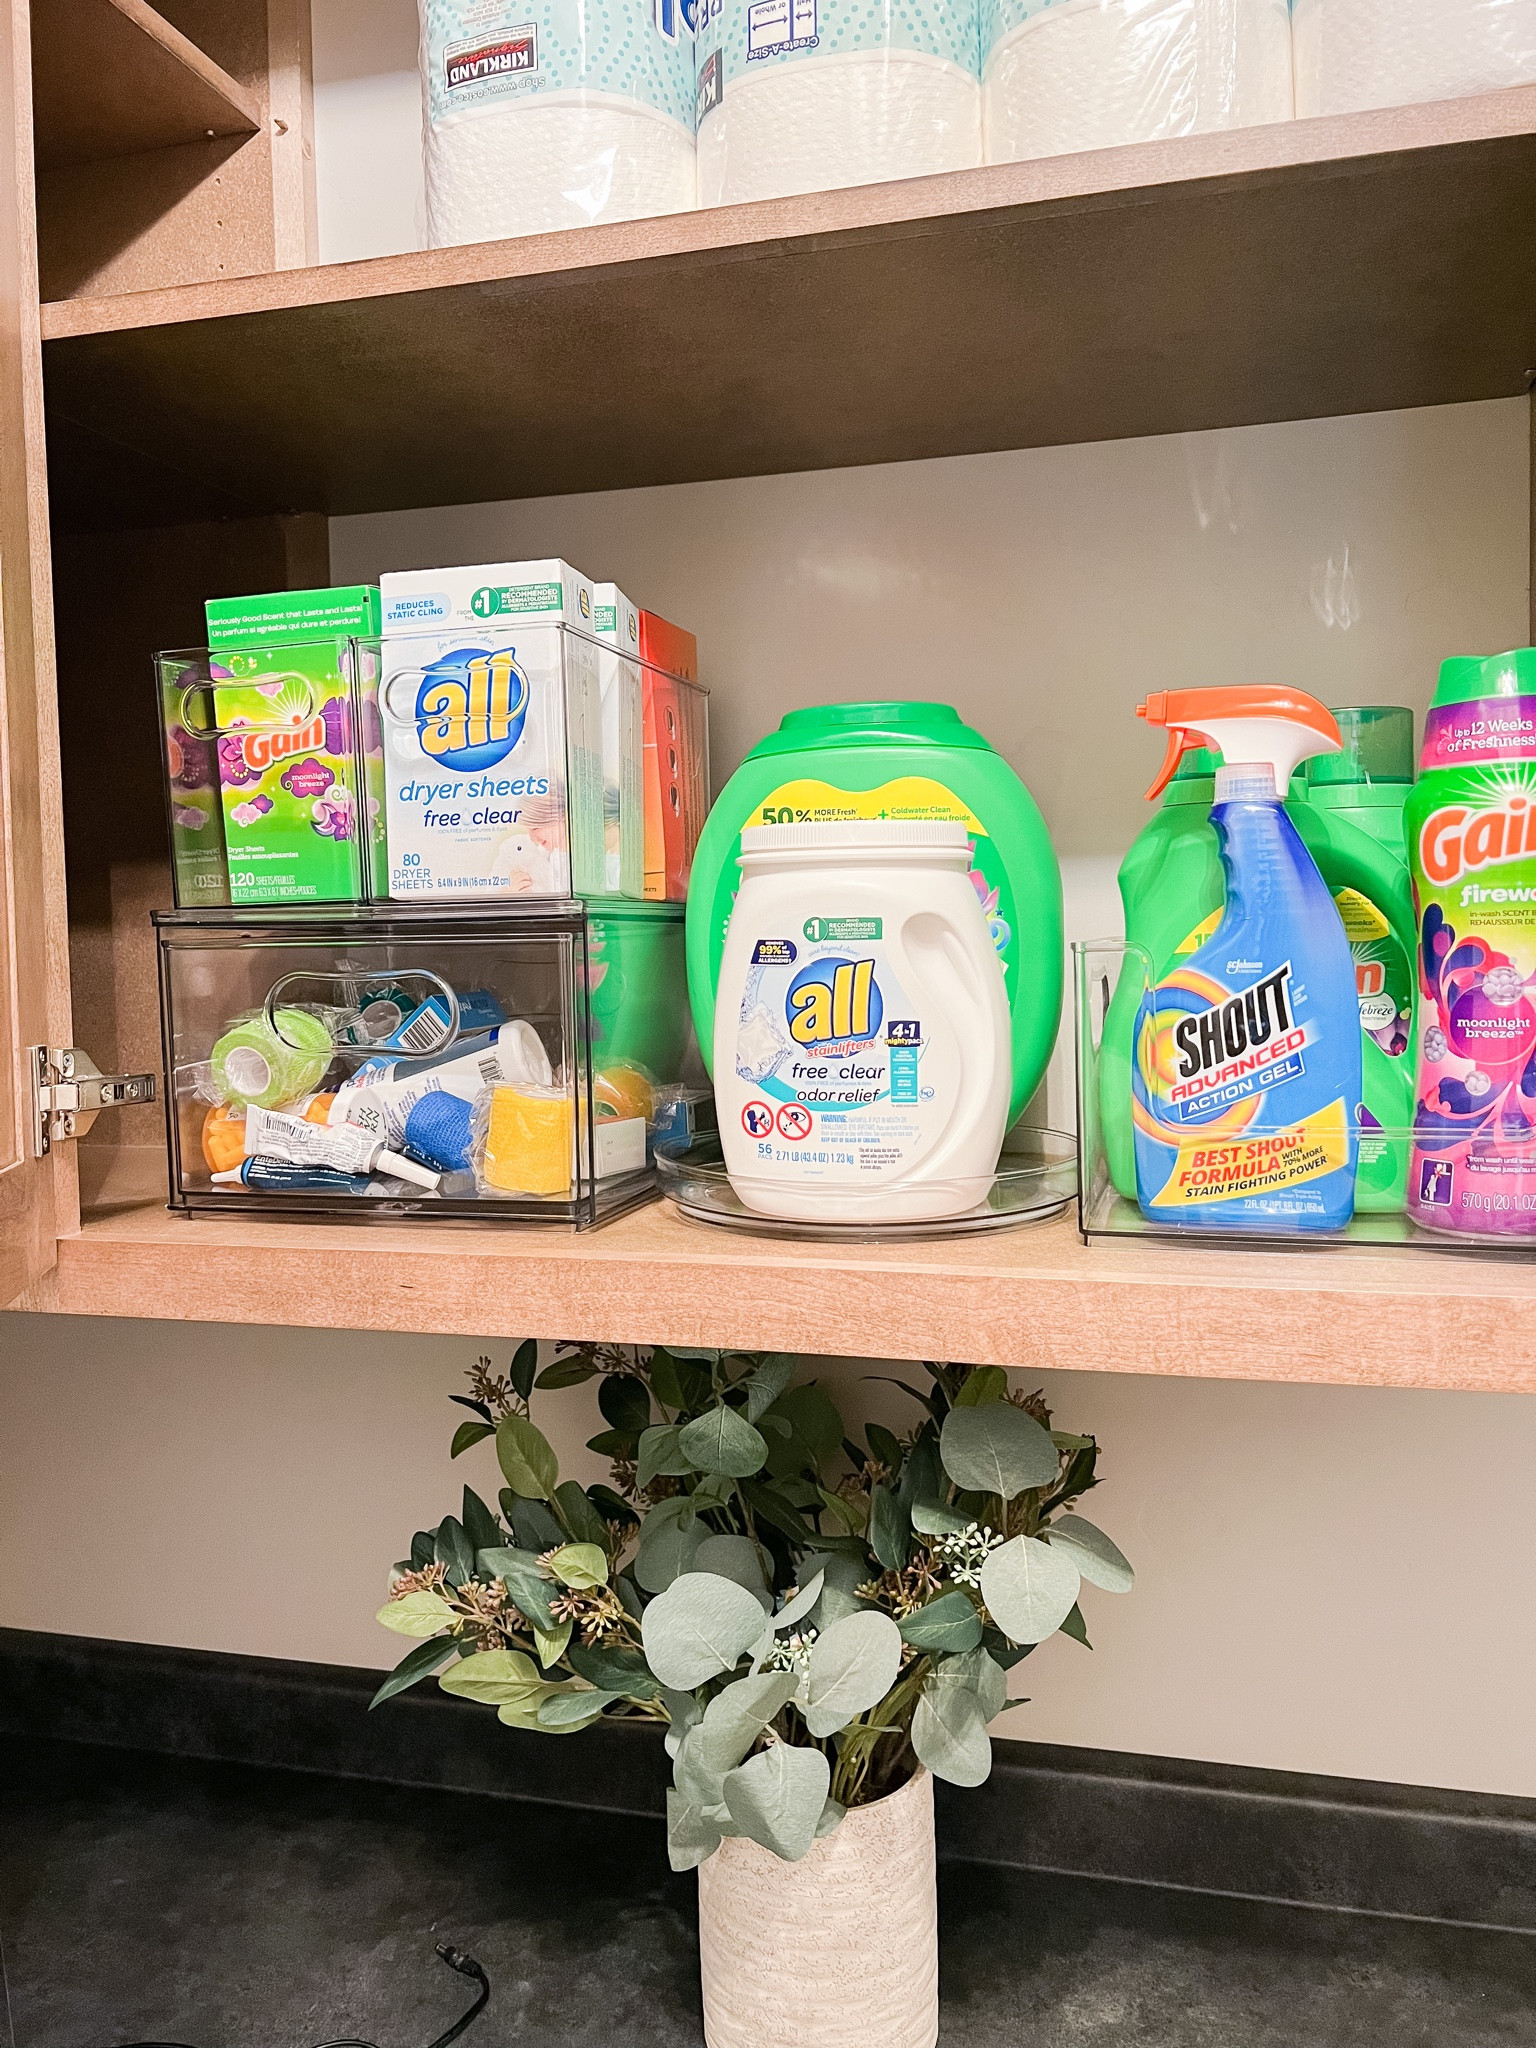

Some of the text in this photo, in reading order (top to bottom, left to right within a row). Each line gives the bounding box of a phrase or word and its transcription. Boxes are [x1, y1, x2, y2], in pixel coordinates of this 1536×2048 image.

[747, 36, 820, 60] Create-A-Size
[450, 50, 529, 83] KIRKLAND
[439, 76, 546, 111] Shop www.costco.com
[474, 590, 490, 614] #1
[501, 588, 558, 600] RECOMMENDED
[387, 607, 443, 620] STATIC CLING
[395, 599, 434, 611] REDUCES
[208, 616, 241, 627] Seriously
[242, 614, 262, 623] Good
[262, 611, 285, 621] Scent
[285, 609, 302, 618] that
[303, 608, 324, 617] Lasts
[324, 606, 340, 615] and
[212, 630, 222, 638] Un
[222, 626, 249, 637] parfum
[288, 621, 300, 631] qui
[301, 618, 318, 628] dure
[319, 619, 328, 627] et
[420, 647, 517, 756] all
[1454, 717, 1534, 738] Up to 12 Weeks
[244, 715, 323, 768] Gain
[1447, 733, 1534, 753] of Freshness
[291, 771, 330, 781] moonlight
[298, 780, 325, 788] breeze
[399, 775, 549, 806] dryer sheets
[423, 807, 523, 828] free clear
[814, 808, 836, 817] MORE
[891, 806, 951, 815] Coldwater Clean
[948, 812, 970, 822] froide
[1422, 797, 1536, 883] Gai
[228, 846, 244, 855] Dryer
[403, 853, 421, 867] 80
[229, 872, 255, 887] 120
[393, 868, 431, 879] DRYER
[458, 877, 462, 887] 9
[479, 878, 487, 886] cm
[492, 876, 499, 886] 22
[391, 879, 434, 890] SHEETS
[1502, 909, 1530, 917] SCENT
[807, 919, 820, 940] #1
[1469, 918, 1523, 926] REHAUSSEUR
[759, 945, 782, 955] 99%
[790, 958, 876, 1044] all
[1176, 965, 1290, 1078] SHOUT
[1456, 1017, 1531, 1029] moonlight
[807, 1040, 876, 1058] stainlifters
[792, 1063, 828, 1079] free
[839, 1063, 886, 1079] clear
[1171, 1028, 1306, 1102] ADVANCED
[797, 1088, 836, 1102] odor
[838, 1088, 881, 1103] relief
[1187, 1060, 1300, 1114] ACTION GEL
[758, 1144, 772, 1154] 56
[1192, 1128, 1306, 1168] BEST SHOUT
[1281, 1147, 1303, 1161] WITH
[1283, 1145, 1324, 1168] 70% MORE
[776, 1150, 790, 1161] 2.71
[791, 1151, 800, 1161] LB
[800, 1151, 817, 1163] (43.4
[818, 1152, 829, 1163] OZ)
[830, 1153, 845, 1163] 1.23
[846, 1154, 854, 1165] kg
[1178, 1155, 1281, 1187] FORMULA
[1480, 1165, 1502, 1174] lavage
[1185, 1184, 1225, 1198] STAIN
[1227, 1172, 1286, 1192] FIGHTING
[1461, 1192, 1482, 1209] 570
[1483, 1197, 1491, 1213] g
[1493, 1192, 1518, 1211] (20.1
